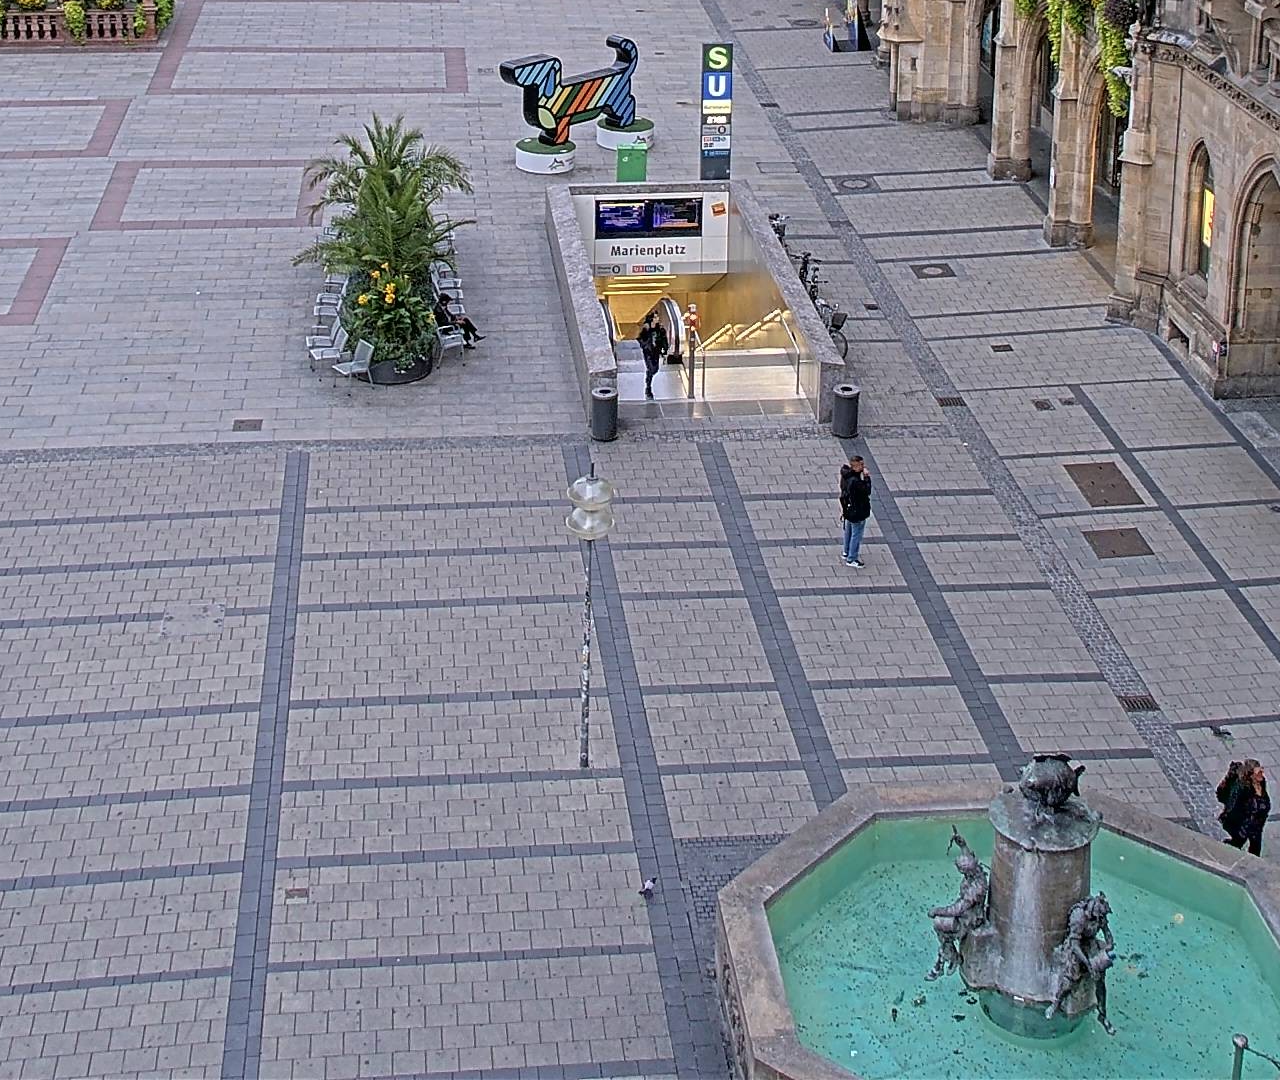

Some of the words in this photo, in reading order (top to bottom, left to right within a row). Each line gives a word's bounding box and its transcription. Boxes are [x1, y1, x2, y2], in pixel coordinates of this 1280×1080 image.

[708, 46, 728, 69] S
[708, 75, 726, 97] U
[610, 244, 686, 258] Marienplatz
